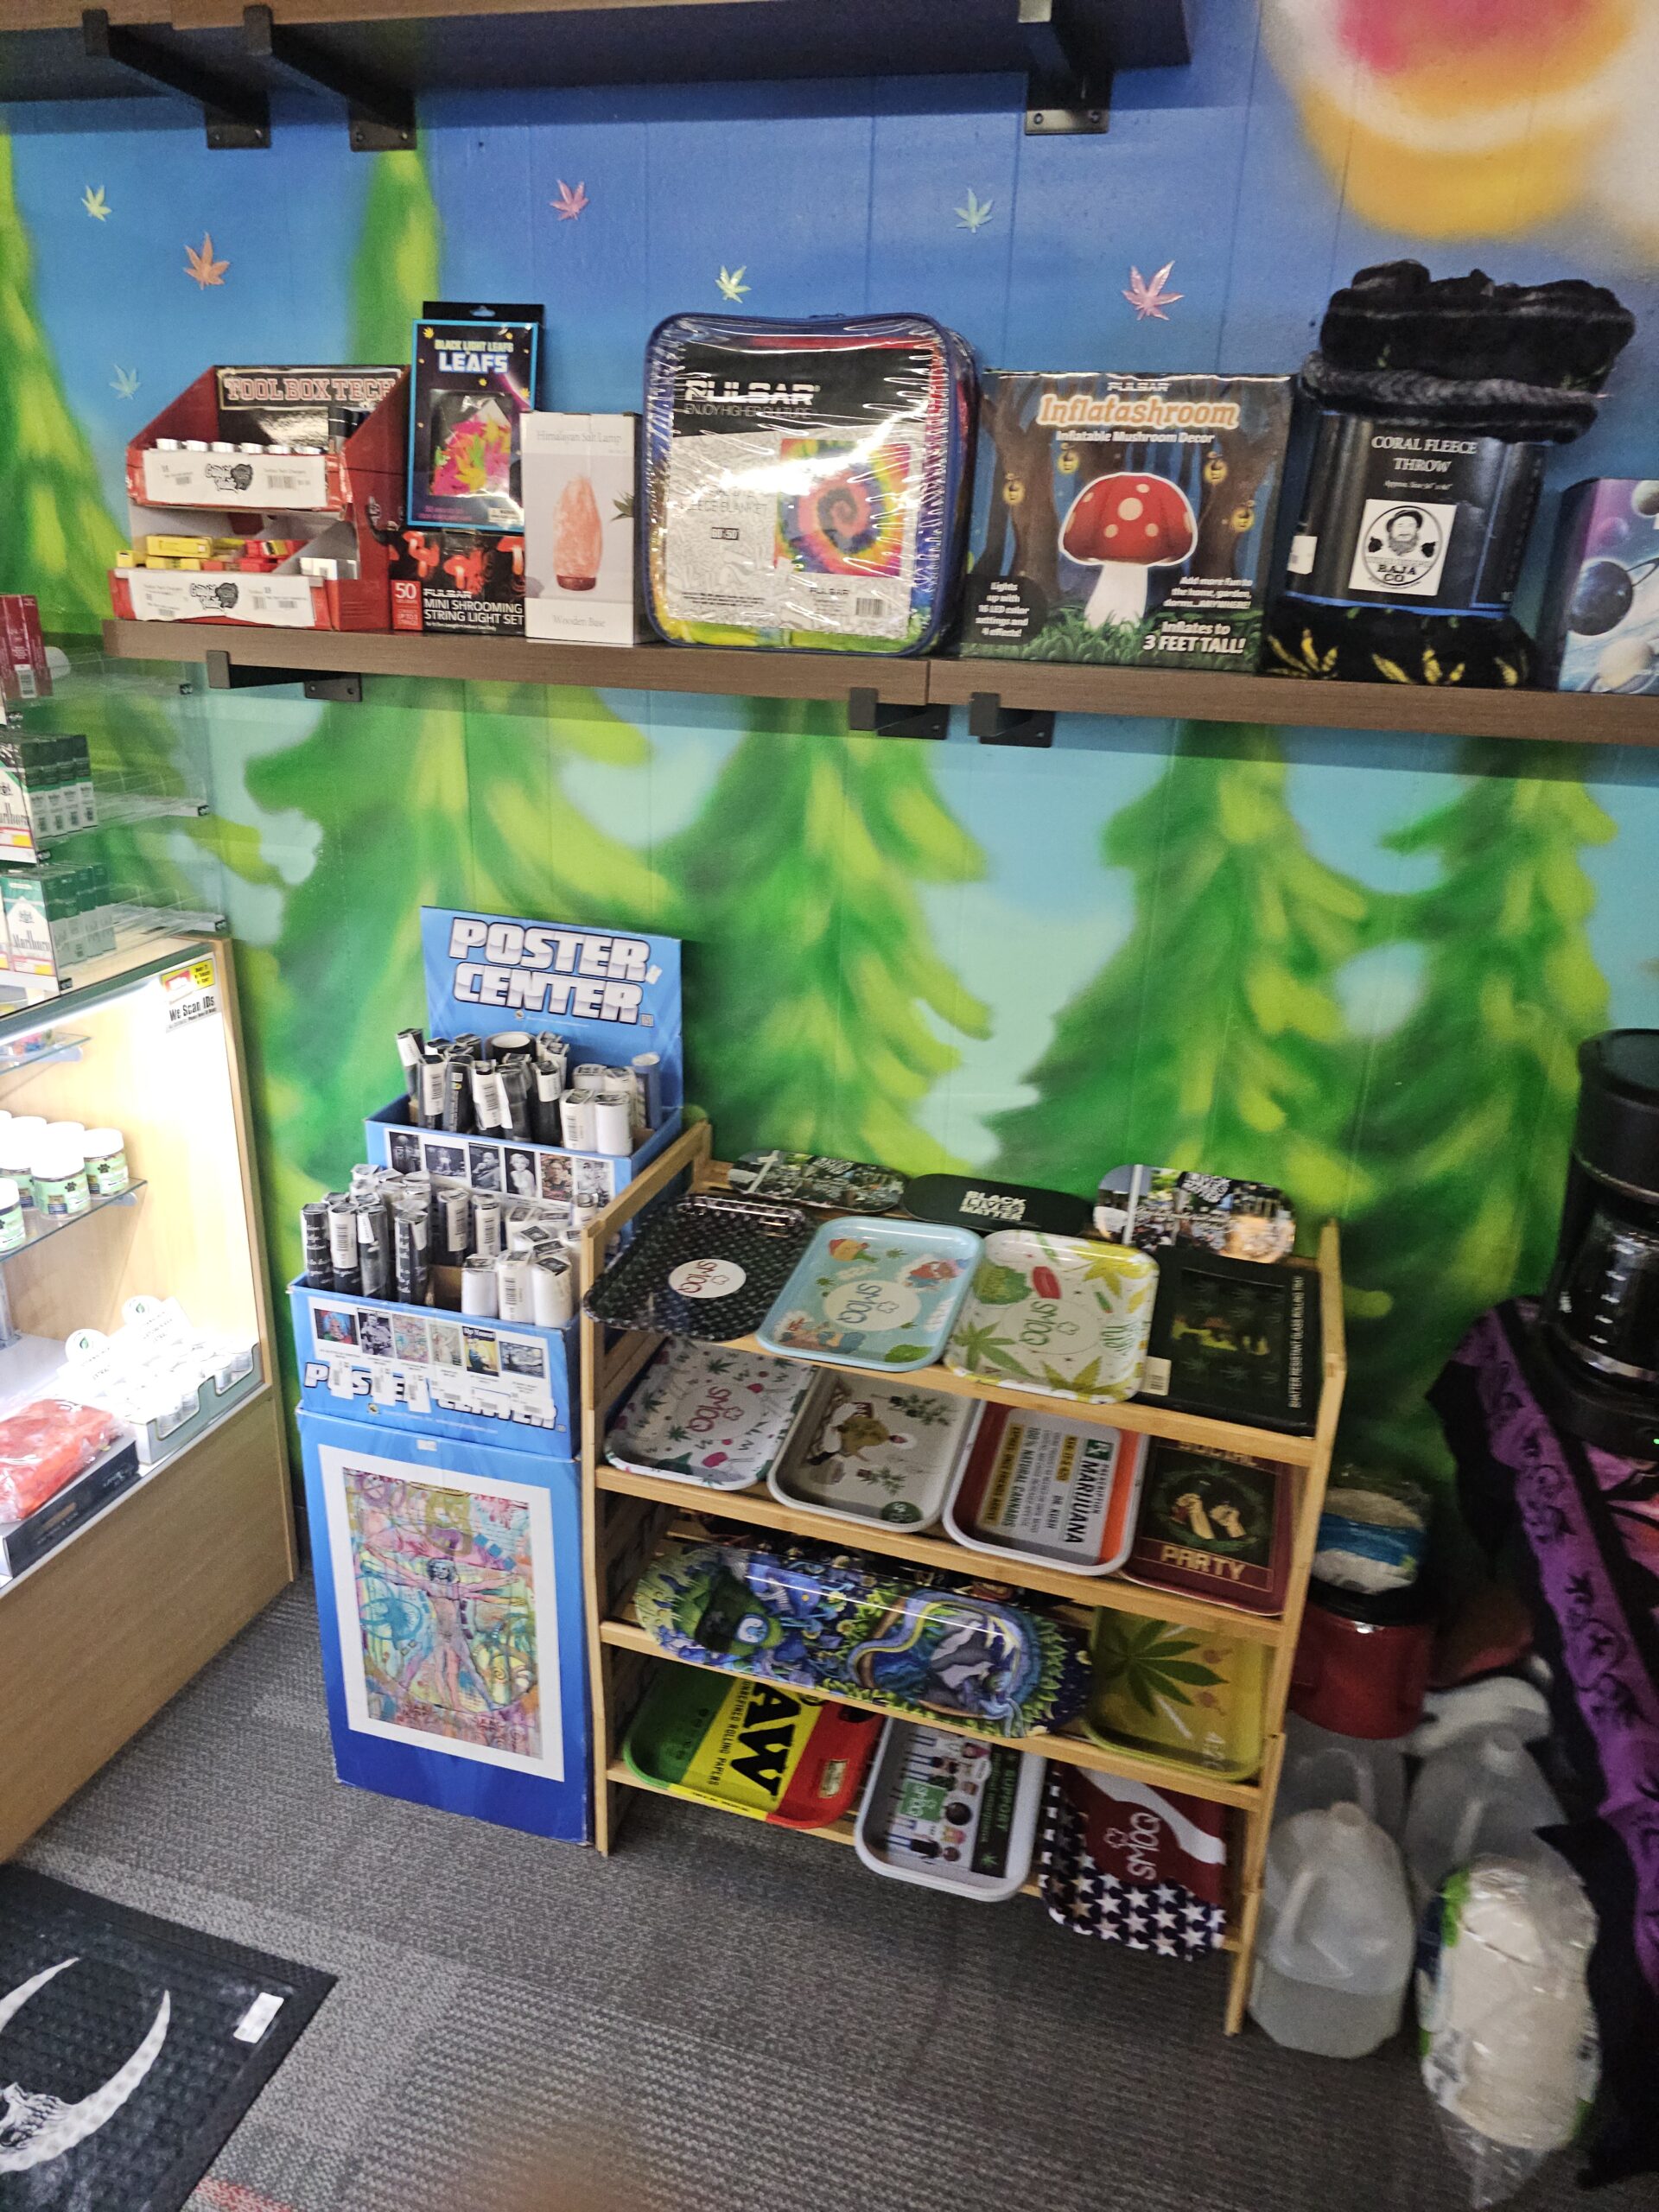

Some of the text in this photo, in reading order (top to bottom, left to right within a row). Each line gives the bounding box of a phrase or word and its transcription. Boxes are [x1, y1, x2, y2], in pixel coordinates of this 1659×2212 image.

[439, 353, 508, 373] LEAFS
[225, 378, 396, 401] TOOL BOX TECH
[1108, 382, 1170, 391] PULSAR
[684, 403, 812, 419] ENJOY HIGHER CULTURE
[1038, 395, 1240, 429] Inflatashroom
[537, 430, 622, 446] Himalayan Salt Lamp
[1056, 430, 1215, 443] Inflatable Mushroom Decor
[1371, 436, 1478, 454] CORAL FLEECE
[1393, 458, 1452, 473] THROW
[721, 501, 767, 515] BLANKET
[395, 582, 417, 599] 50
[990, 582, 1018, 592] Lights
[1188, 588, 1216, 598] home,
[1216, 589, 1252, 600] garden,
[424, 599, 449, 609] MINI
[451, 601, 523, 613] SHROOMING
[424, 609, 524, 625] STRING LIGHT SET
[552, 614, 587, 626] Wooden
[1161, 621, 1230, 635] Inflates to
[1143, 634, 1246, 653] 3 FEET TALL!
[449, 917, 650, 982] POSTER
[454, 961, 643, 1024] CENTER
[169, 1008, 181, 1020] We
[182, 1001, 200, 1016] Scan
[203, 995, 214, 1008] IDs
[677, 1261, 717, 1294] SMOQ
[836, 1282, 882, 1324] SMOQ
[1291, 1292, 1305, 1319] ROLLING
[1019, 1301, 1058, 1345] SMOQ
[1290, 1319, 1304, 1339] GLASS
[1288, 1340, 1303, 1376] RESISTANT
[1287, 1376, 1302, 1408] SHATTER
[684, 1386, 732, 1432] SMOQ
[1001, 1426, 1040, 1529] 100% NATURAL CANNABIS
[1091, 1463, 1109, 1515] PRESCRIPTION
[1065, 1459, 1099, 1545] MARIJUANA
[1046, 1508, 1060, 1529] KUSH
[1160, 1544, 1246, 1580] PARTY
[719, 1724, 740, 1754] ROLLING
[731, 1682, 801, 1796] AW
[707, 1757, 727, 1786] PAPERS
[995, 1768, 1016, 1831] SUPPORT
[1127, 1812, 1163, 1880] SMOQ
